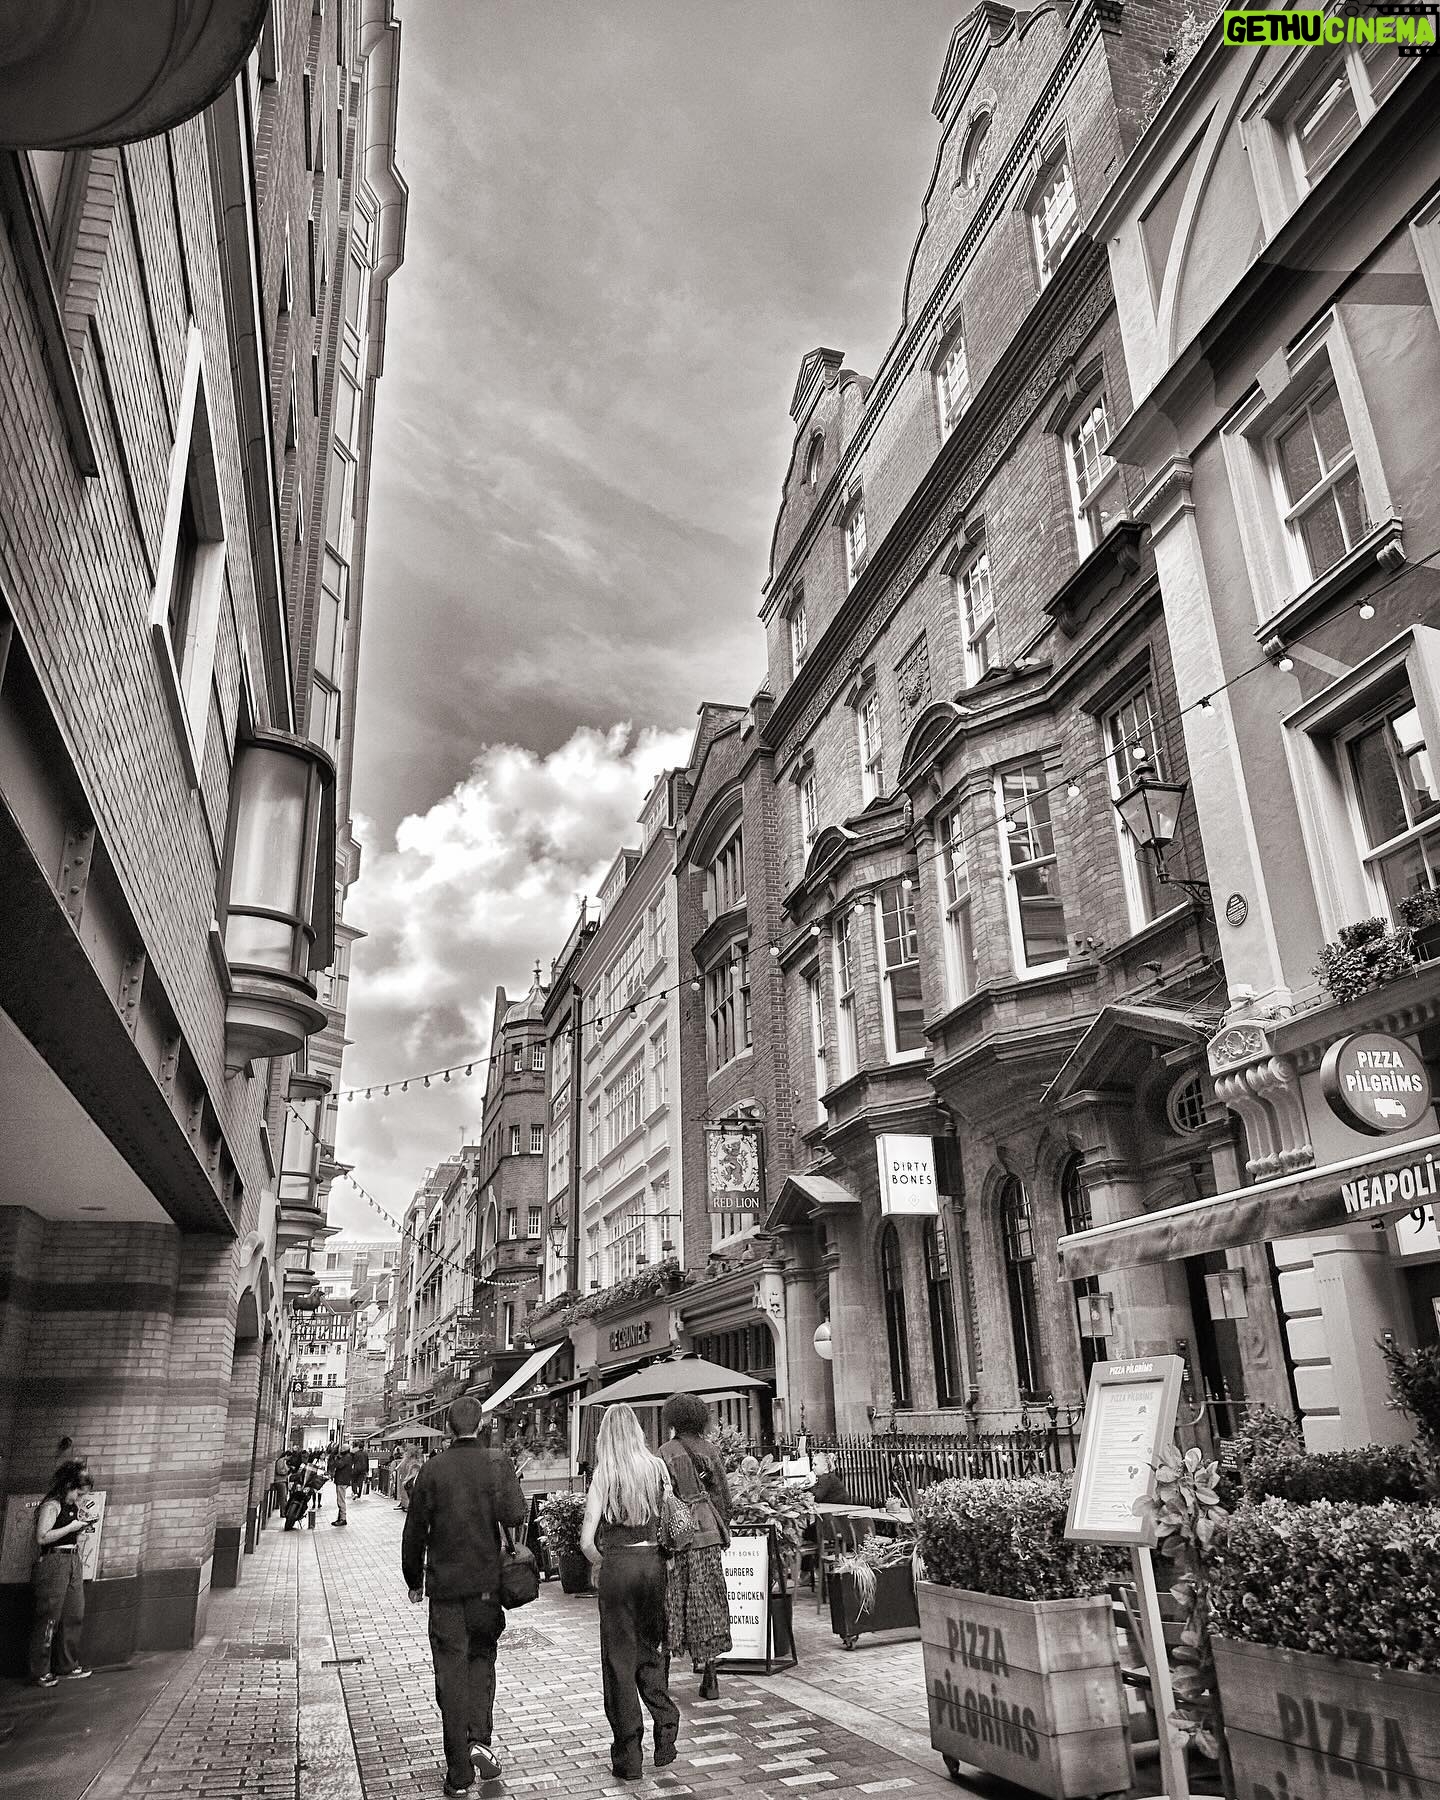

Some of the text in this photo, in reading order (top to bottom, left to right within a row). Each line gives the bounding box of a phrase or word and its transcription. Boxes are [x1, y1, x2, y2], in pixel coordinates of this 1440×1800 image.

[1356, 1051, 1404, 1068] PIZZA
[893, 1161, 927, 1171] DIRTY
[892, 1174, 932, 1185] BONES
[713, 1197, 759, 1208] RED LION
[1109, 1366, 1125, 1375] PIZZA
[1111, 1391, 1127, 1402] PIZZA
[725, 1567, 754, 1577] BURGERS
[737, 1591, 765, 1601] CHICKEN
[729, 1615, 760, 1625] OCKTAILS
[946, 1617, 1010, 1678] PIZZA
[1276, 1691, 1423, 1800] PIZZA
